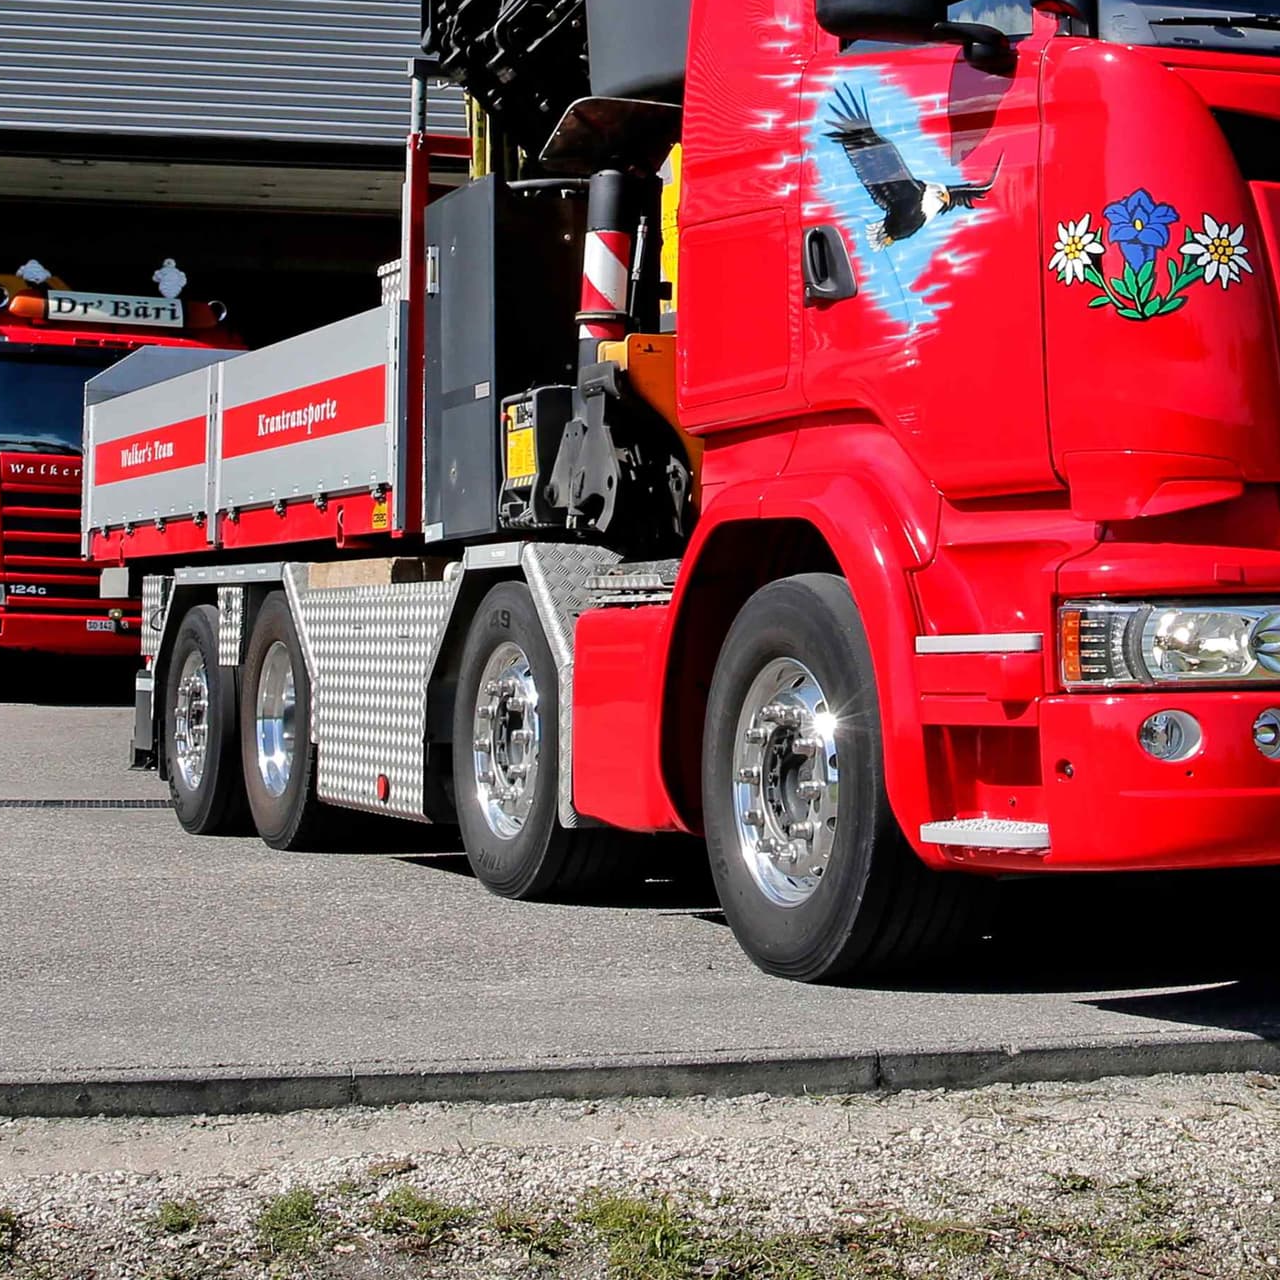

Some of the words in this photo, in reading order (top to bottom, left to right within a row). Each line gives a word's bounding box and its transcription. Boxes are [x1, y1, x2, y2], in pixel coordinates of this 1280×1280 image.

[110, 299, 181, 320] Bäri
[257, 397, 337, 437] Krantransporte
[154, 440, 174, 461] Team
[10, 463, 81, 477] Walker
